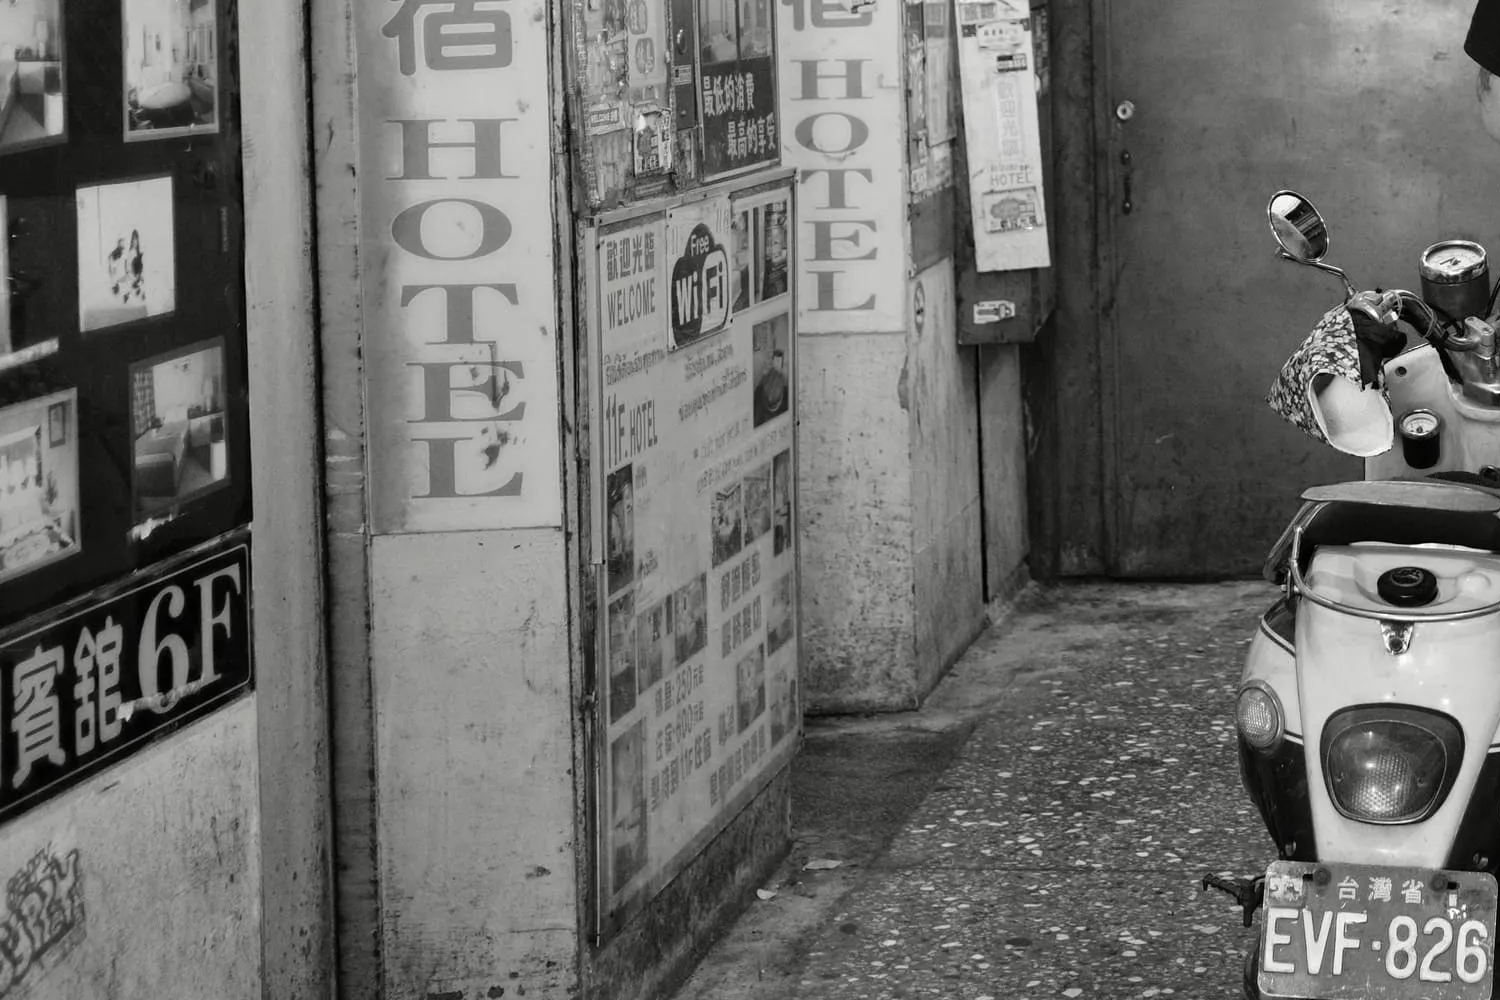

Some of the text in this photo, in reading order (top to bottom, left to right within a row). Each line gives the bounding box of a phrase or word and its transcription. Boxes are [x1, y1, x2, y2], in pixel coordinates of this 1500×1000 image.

[789, 57, 878, 312] HOTEL
[606, 231, 655, 282] 歡迎光臨
[690, 233, 710, 257] Free
[384, 117, 527, 499] HOTEL
[606, 276, 656, 330] WELCOME
[629, 399, 659, 455] HOTEL
[11, 562, 242, 790] 賓館 6F
[1337, 875, 1425, 905] 台灣省
